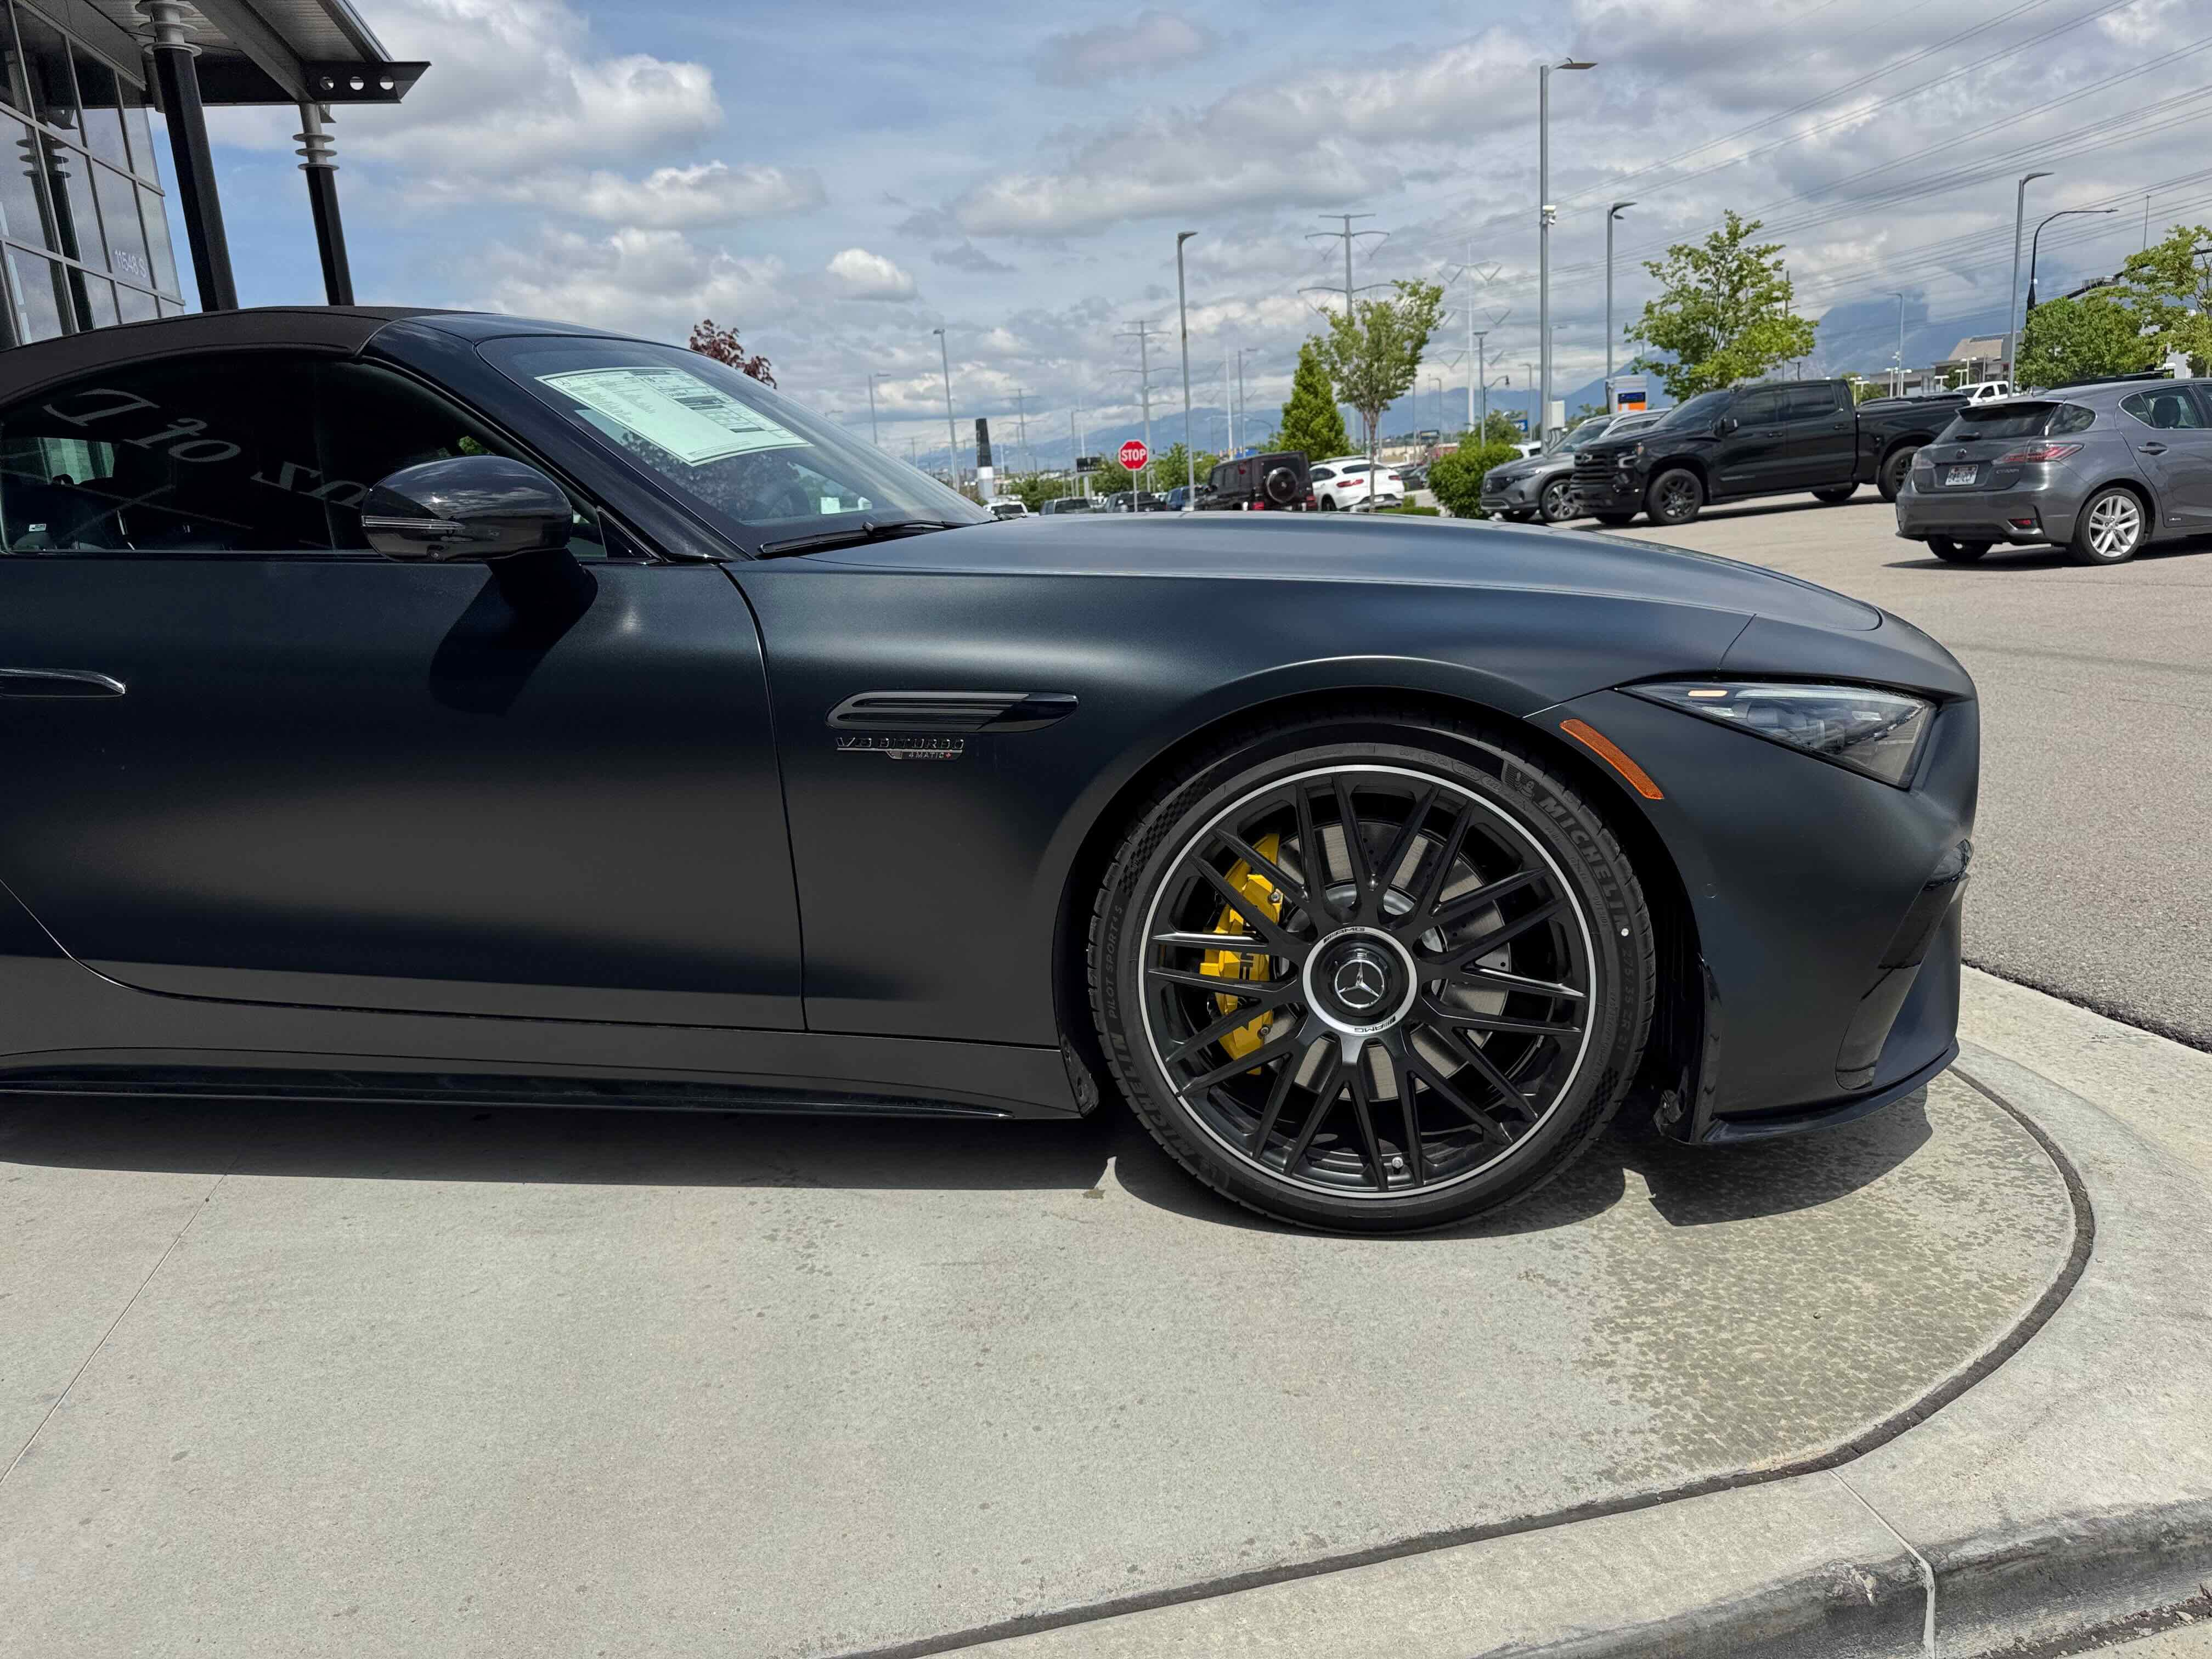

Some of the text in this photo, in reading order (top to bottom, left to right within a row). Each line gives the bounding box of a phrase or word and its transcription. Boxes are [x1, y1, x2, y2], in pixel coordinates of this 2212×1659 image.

[1121, 448, 1147, 462] STOP
[837, 737, 964, 749] V8 BITURBO
[1538, 796, 1632, 932] MICHELIN
[1334, 927, 1365, 936] AMG
[1105, 922, 1120, 973] SPORT
[1106, 977, 1118, 1019] PILOT
[1354, 1024, 1384, 1033] AMG
[1110, 1034, 1197, 1158] MICHELIN
